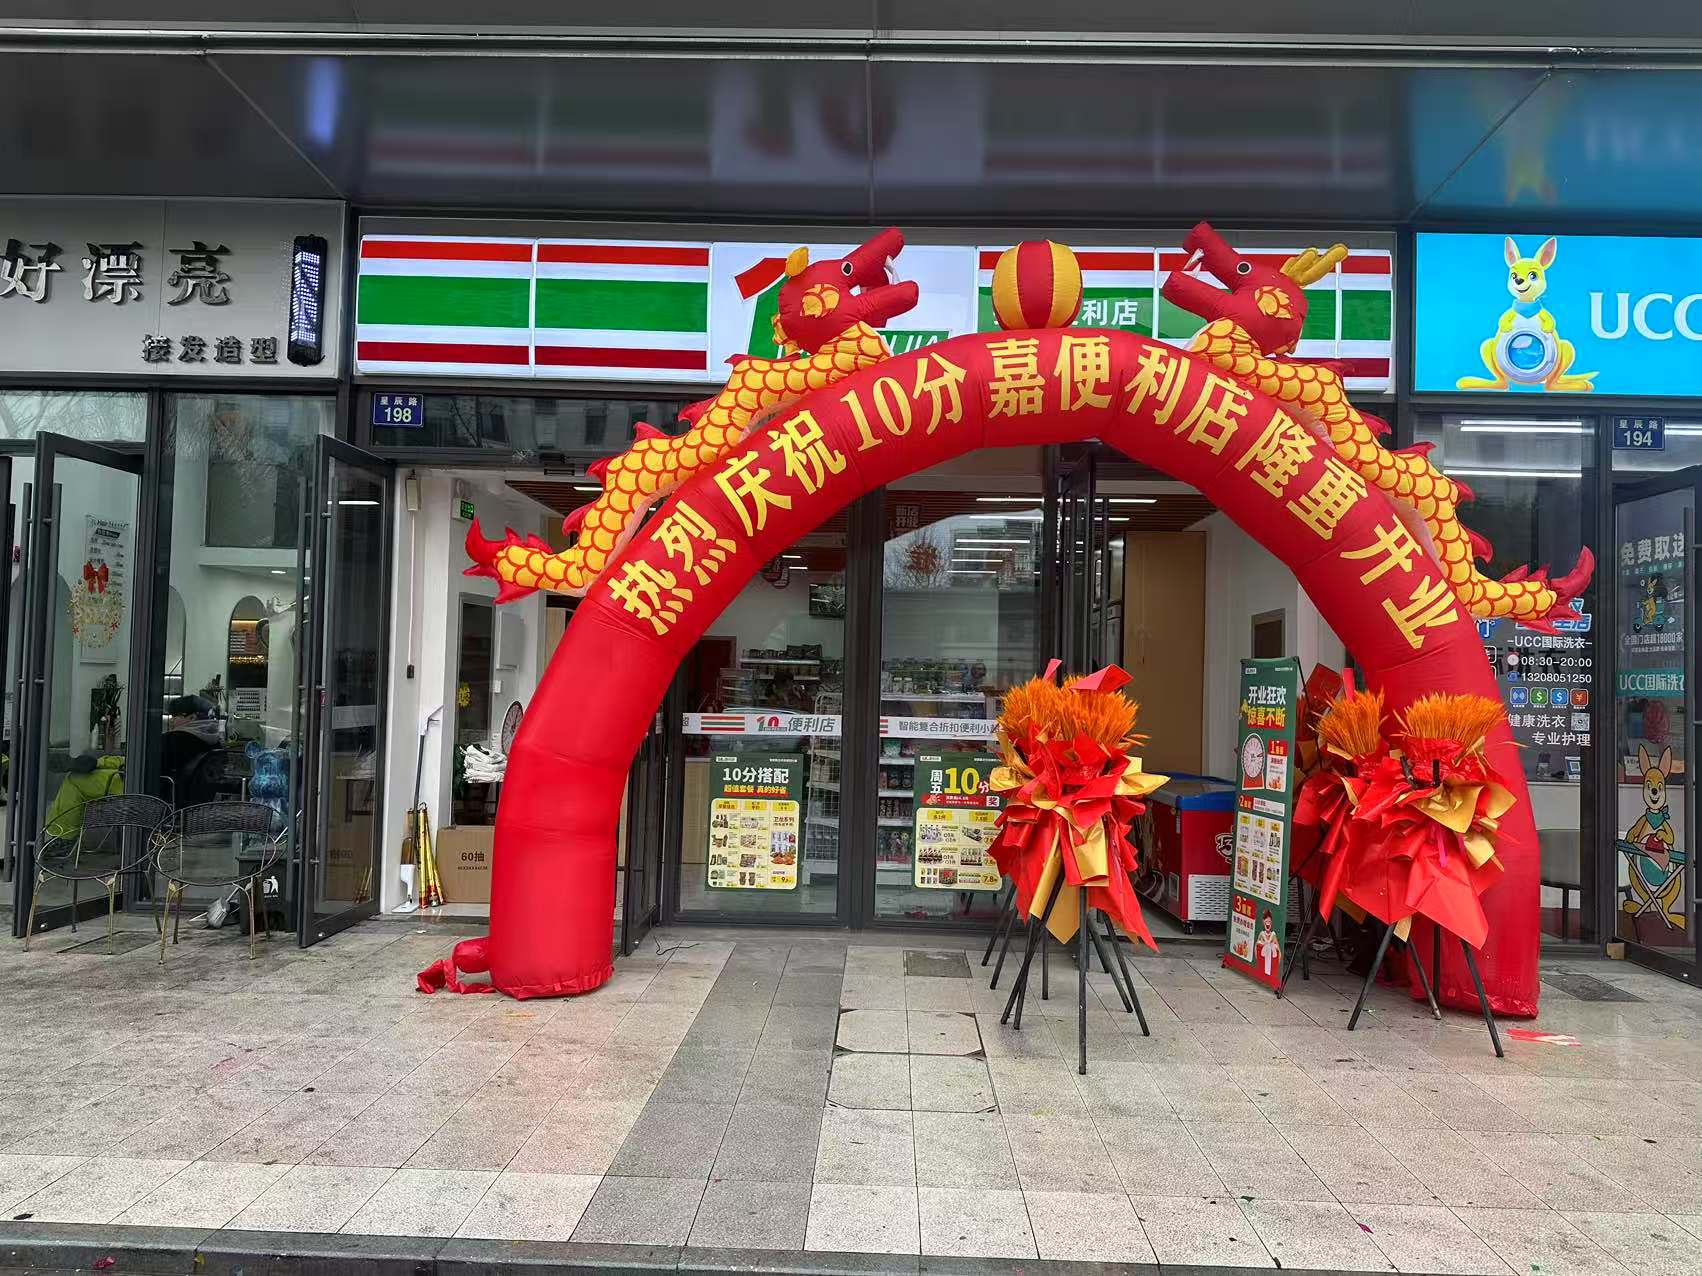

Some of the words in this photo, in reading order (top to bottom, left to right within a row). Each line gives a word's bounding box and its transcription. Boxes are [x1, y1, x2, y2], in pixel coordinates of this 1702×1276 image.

[0, 238, 233, 305] 好漂亮
[141, 334, 279, 364] 接发造型
[380, 395, 418, 406] 星辰路
[384, 407, 412, 422] 198
[1618, 419, 1658, 430] 星辰路
[1623, 431, 1653, 447] 194
[1521, 672, 1592, 683] 13208051250
[1248, 685, 1287, 705] 开业狂欢
[788, 716, 836, 733] 便利店
[1508, 713, 1566, 728] 健康洗衣
[1532, 731, 1592, 747] 专业护理
[722, 767, 789, 784] 10分搭配
[461, 850, 484, 863] 60抽
